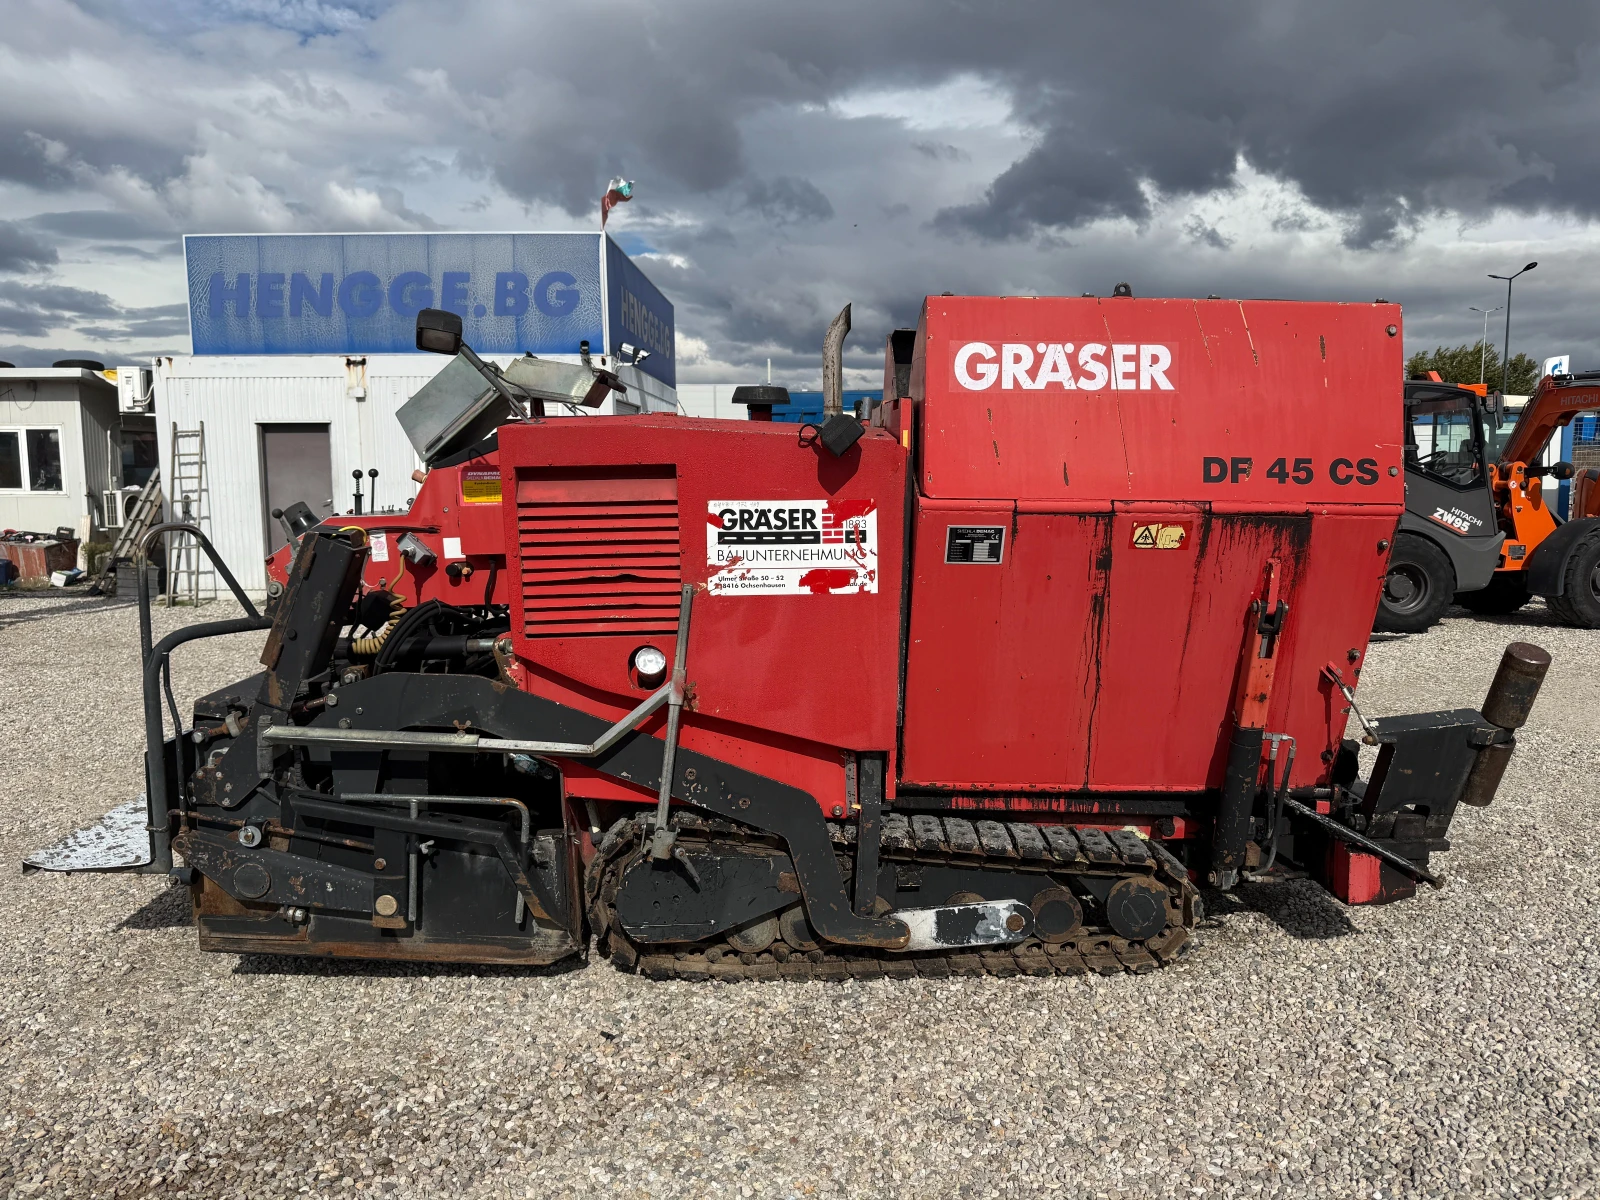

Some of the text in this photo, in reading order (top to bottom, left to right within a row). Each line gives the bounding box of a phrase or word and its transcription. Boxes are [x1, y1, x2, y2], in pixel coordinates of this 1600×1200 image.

[210, 270, 580, 318] HENGGE.BG
[954, 342, 1175, 390] GRÄSER
[1560, 393, 1599, 406] HITACHI
[1203, 456, 1379, 486] DF 45 CS
[718, 508, 818, 531] GRÄSER
[1433, 507, 1471, 532] ZW95
[1450, 507, 1483, 527] HITACHI
